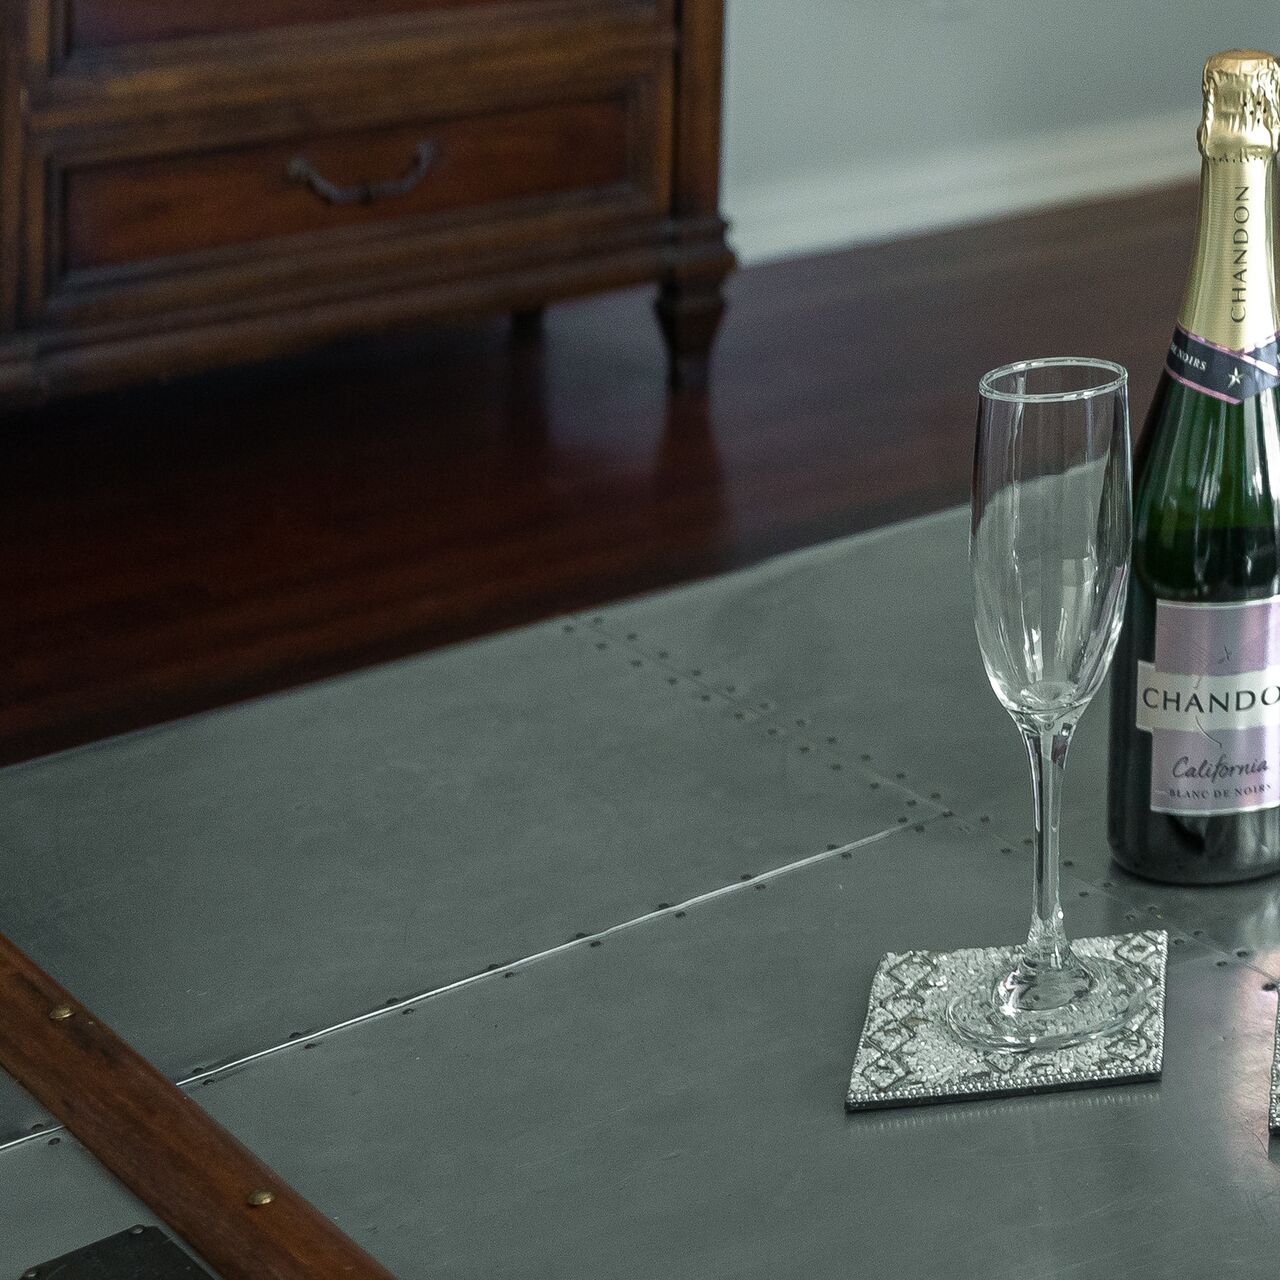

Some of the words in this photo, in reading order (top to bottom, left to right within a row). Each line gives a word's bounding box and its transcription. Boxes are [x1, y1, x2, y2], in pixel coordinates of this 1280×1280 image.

[1230, 185, 1250, 324] CHANDON
[1172, 753, 1269, 784] California
[1169, 788, 1210, 799] BLANC
[1214, 789, 1228, 798] DE
